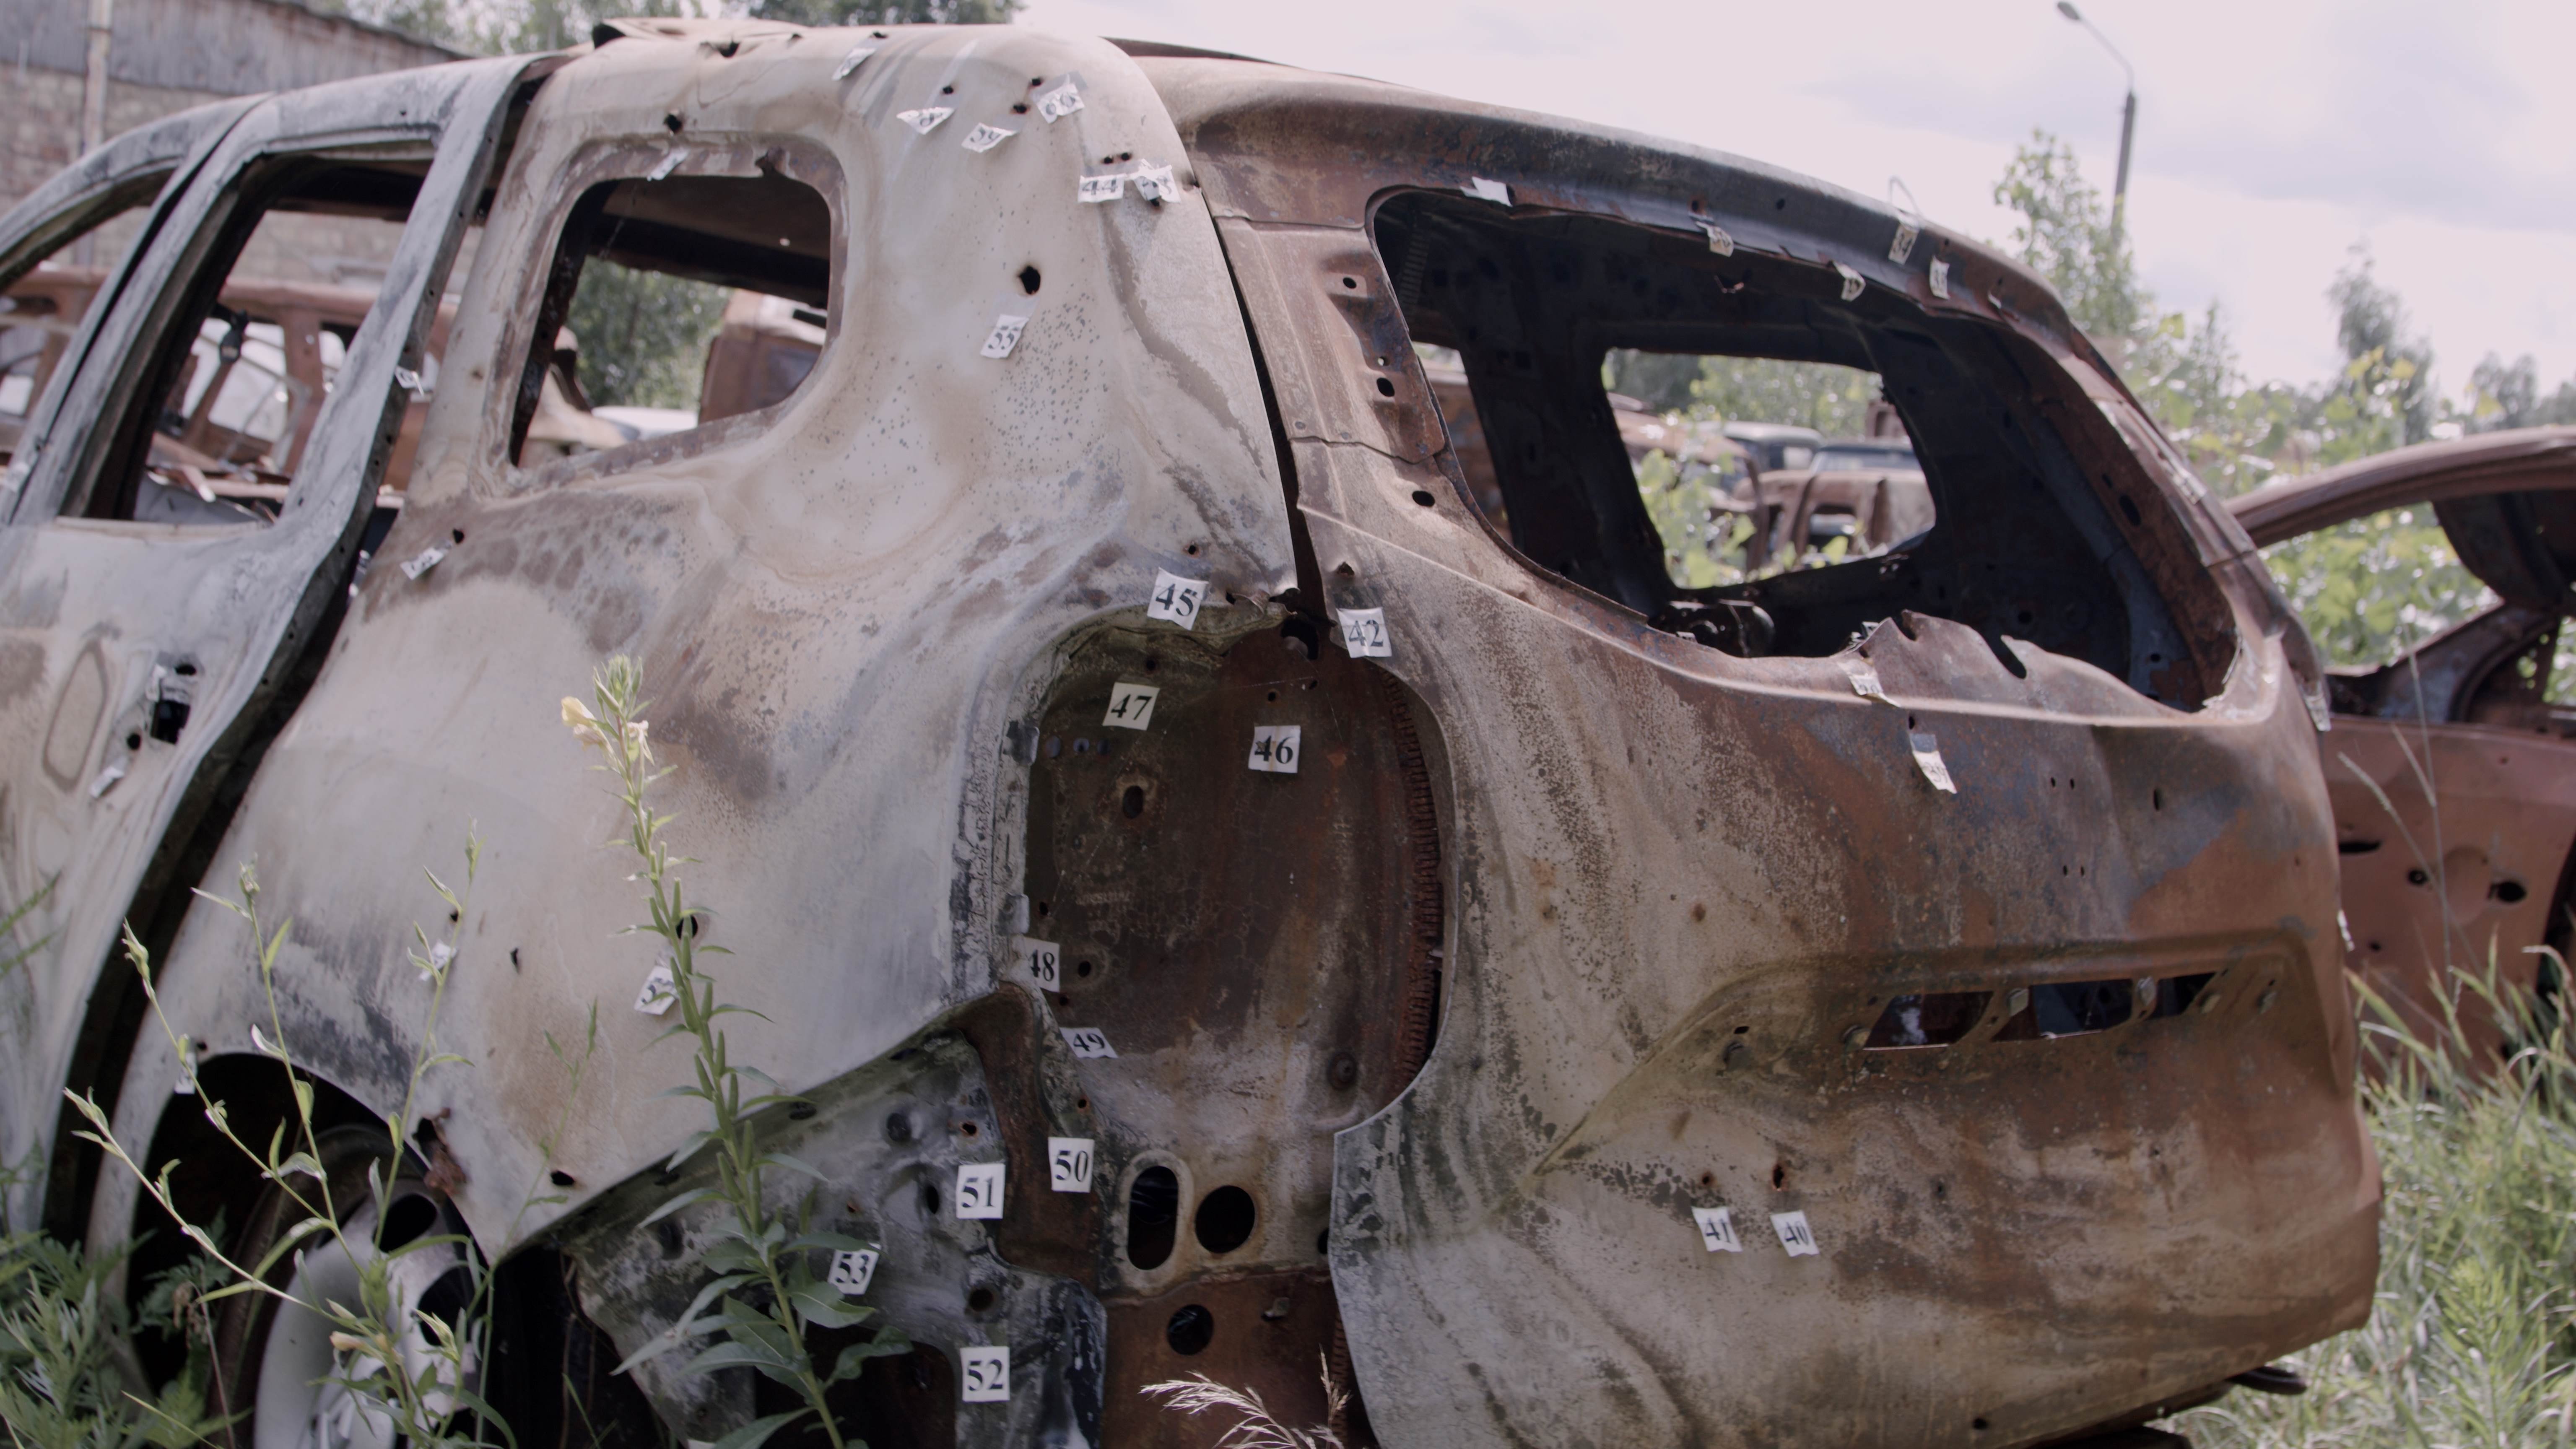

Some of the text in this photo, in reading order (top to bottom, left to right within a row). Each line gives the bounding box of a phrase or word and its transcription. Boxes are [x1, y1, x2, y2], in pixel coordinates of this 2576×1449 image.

[1082, 179, 1118, 196] 44
[988, 325, 1021, 351] 55
[1155, 583, 1197, 616] 45
[1348, 619, 1384, 647] 42
[1111, 693, 1152, 721] 47
[1254, 735, 1294, 764] 46
[1030, 948, 1055, 982] 48
[1073, 1033, 1106, 1052] 49
[1055, 1149, 1089, 1183] 50
[961, 1176, 996, 1208] 51
[1705, 1216, 1732, 1244] 41
[1784, 1221, 1810, 1247] 40
[836, 1251, 871, 1284] 53
[967, 1358, 1005, 1392] 52
